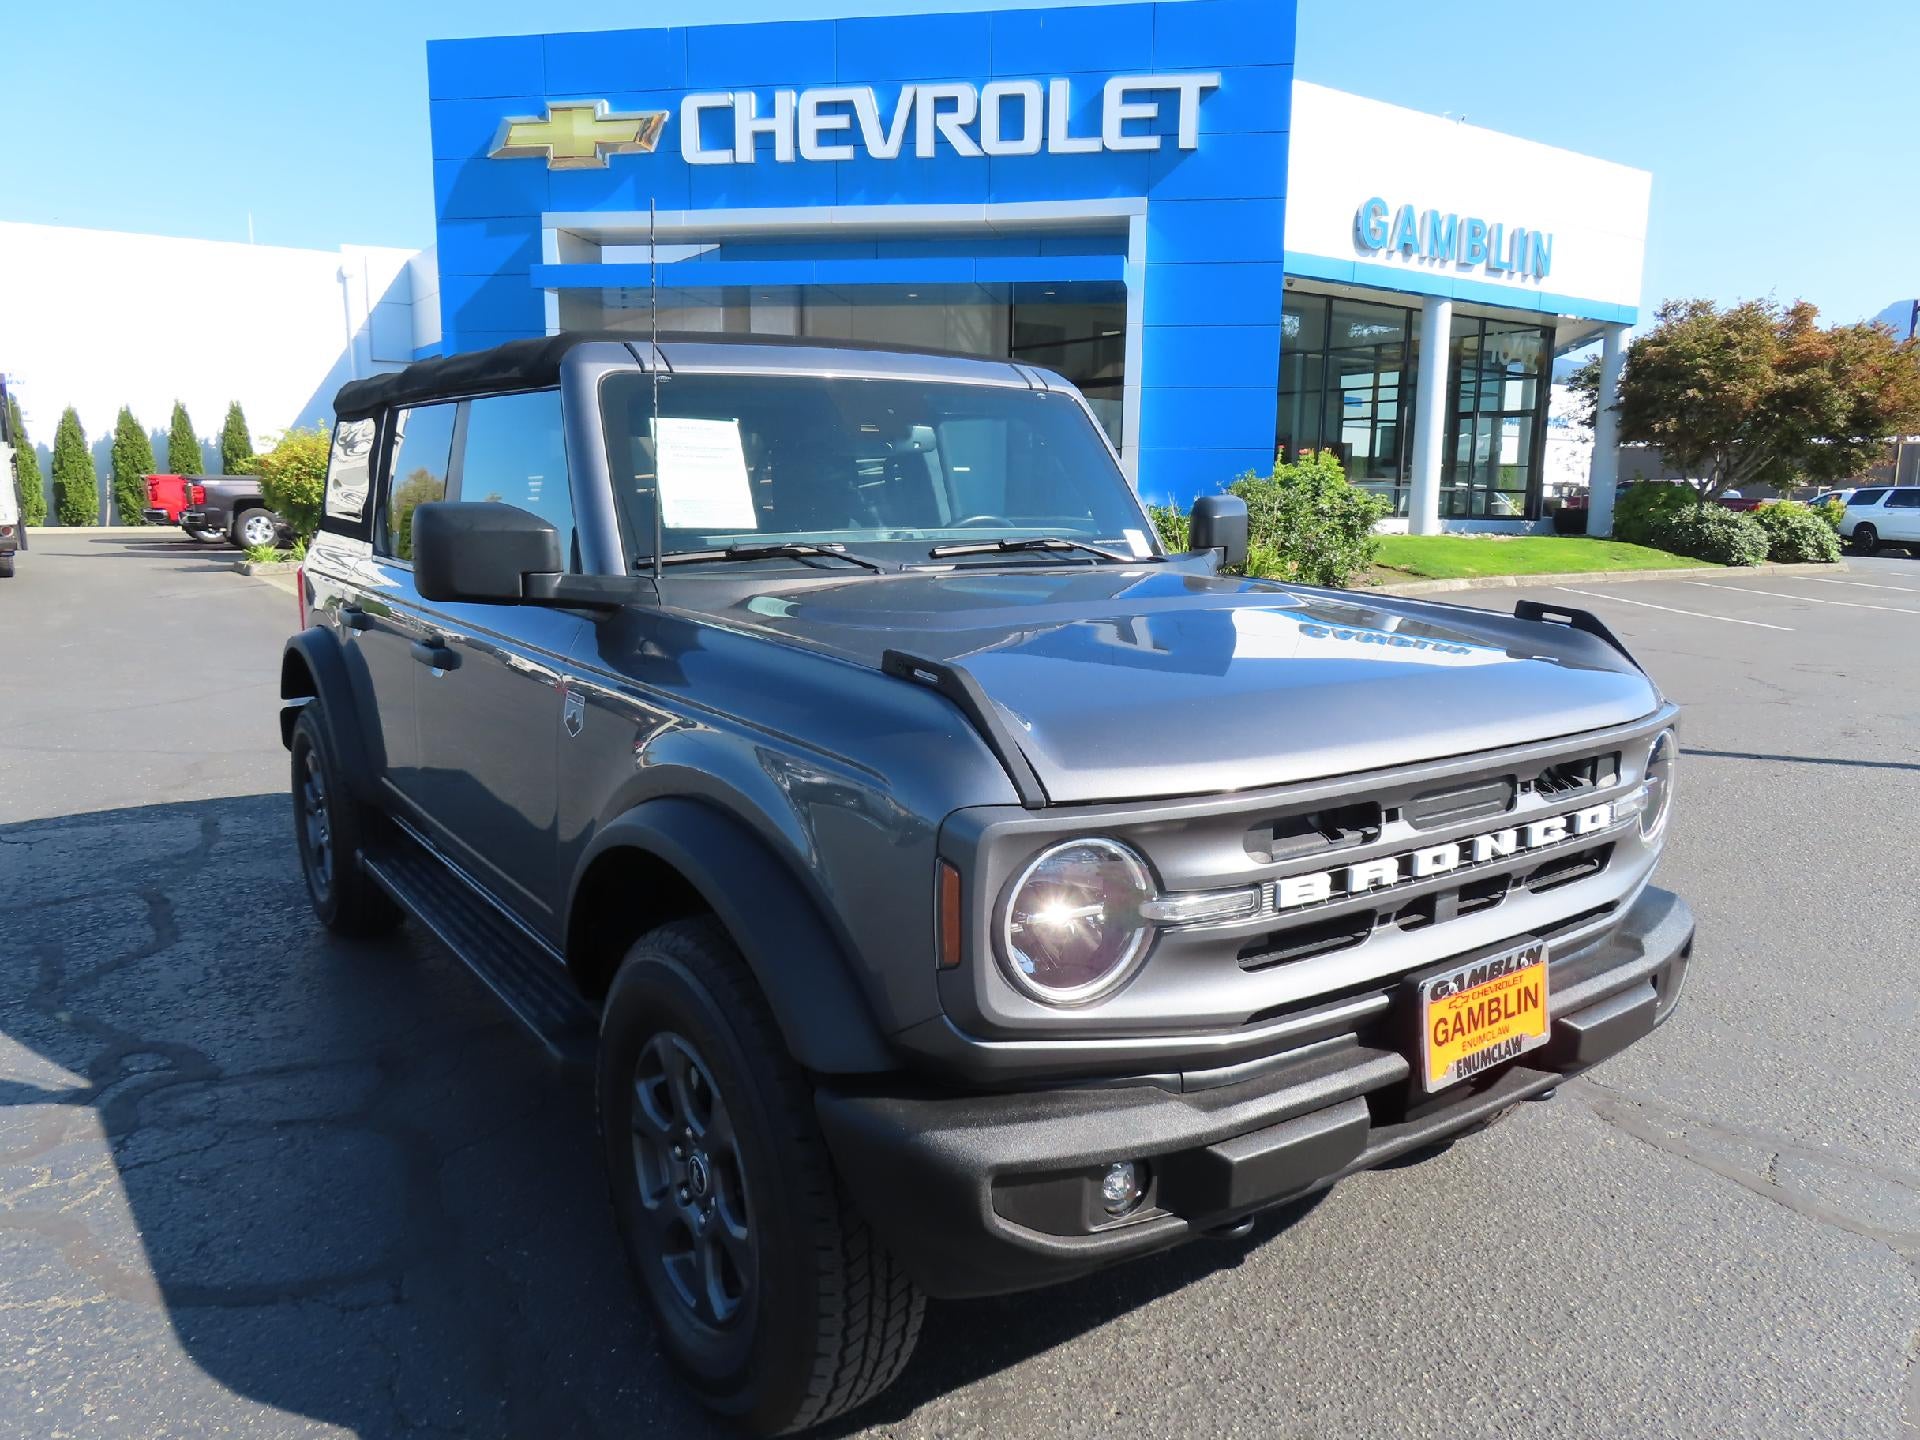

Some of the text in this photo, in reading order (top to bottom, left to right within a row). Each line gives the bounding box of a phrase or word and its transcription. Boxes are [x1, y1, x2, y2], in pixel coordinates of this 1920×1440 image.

[681, 73, 1221, 164] CHEVROLET
[1353, 197, 1553, 276] GAMBLIN
[1275, 804, 1613, 908] BRONCO
[1430, 945, 1544, 1001] GAMBLIN
[1471, 975, 1524, 1000] CHEVROLET
[1433, 983, 1539, 1047] GAMBLIN
[1461, 1024, 1510, 1052] ENUMCLAW
[1456, 1034, 1523, 1079] ENUMCLAW
